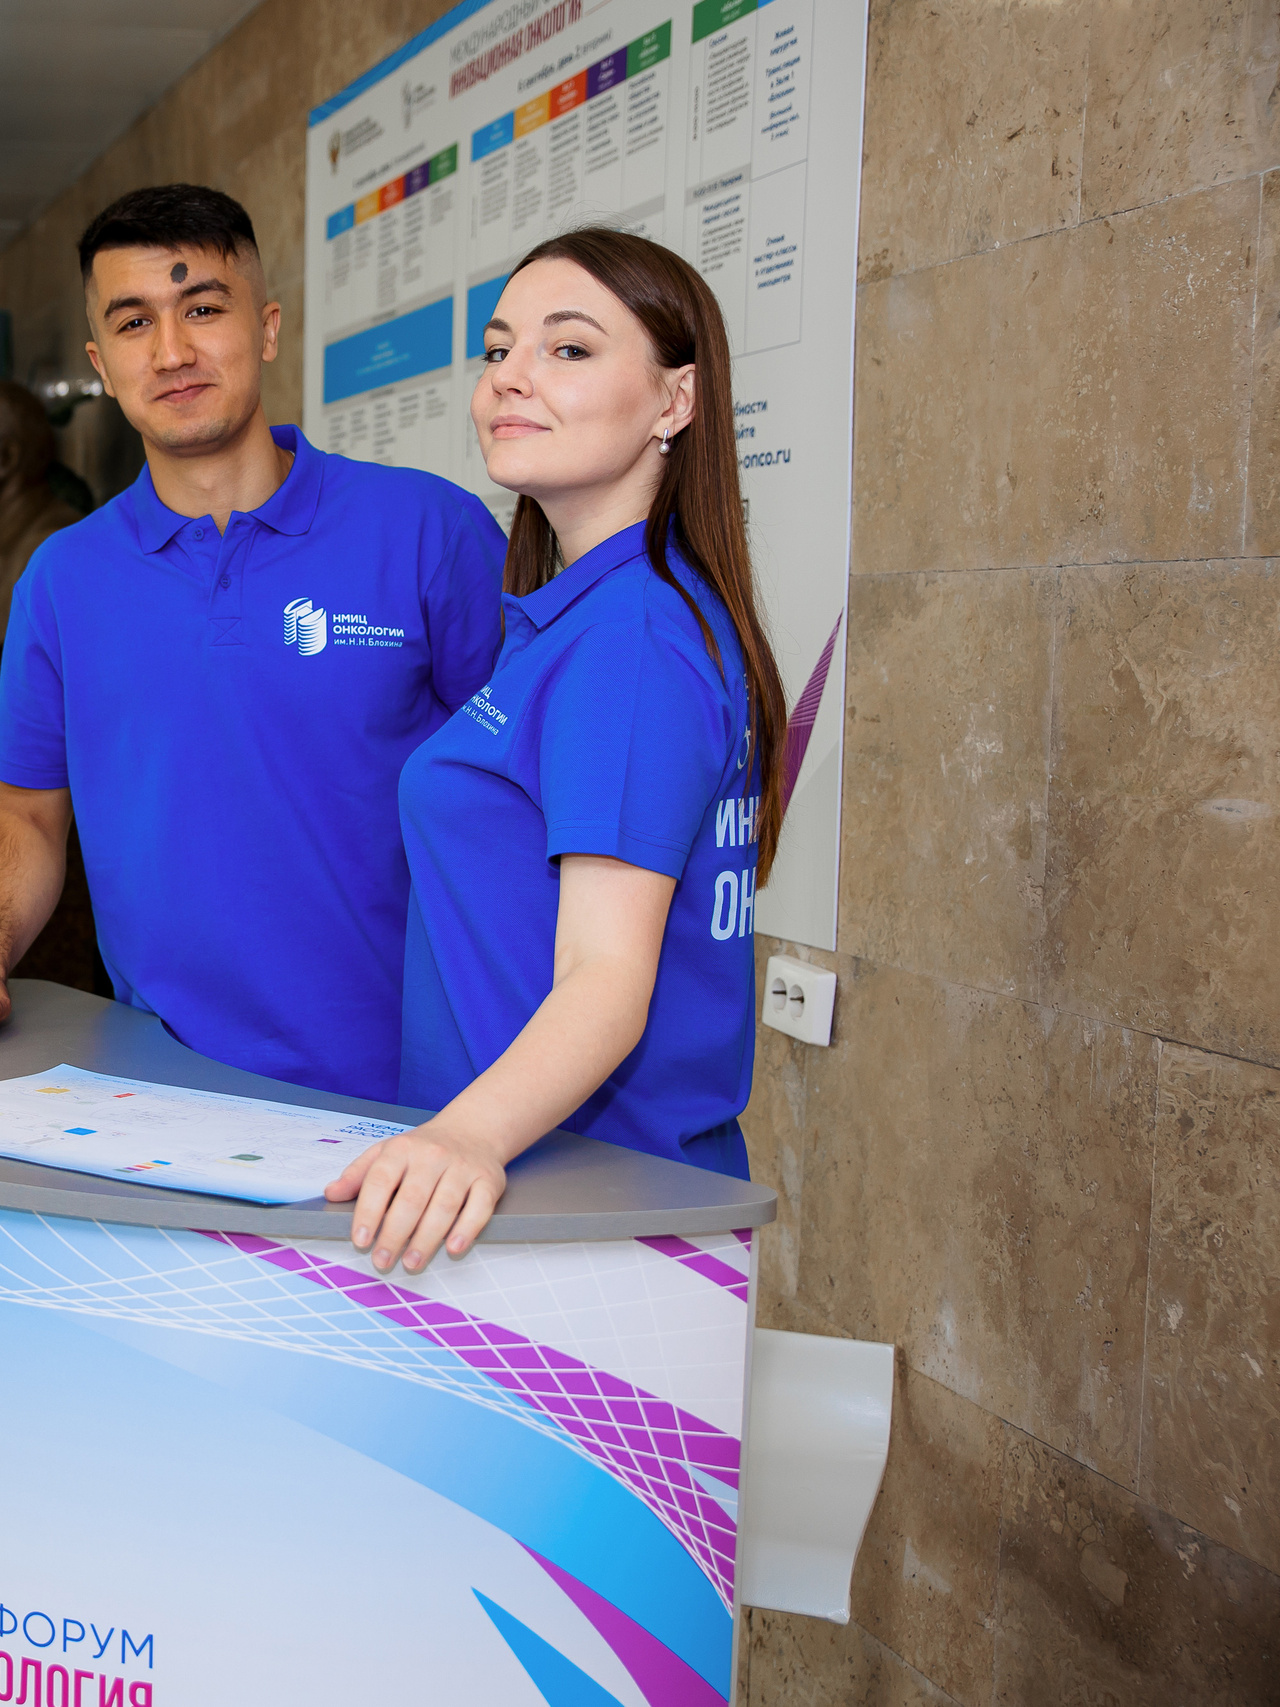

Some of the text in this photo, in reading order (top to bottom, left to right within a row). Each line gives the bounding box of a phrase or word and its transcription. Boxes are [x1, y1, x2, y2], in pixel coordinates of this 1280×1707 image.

[733, 400, 767, 417] бности
[738, 448, 791, 469] -onco.ru
[332, 614, 368, 625] НМИЦ
[332, 625, 405, 638] ОНКОЛОГИИ
